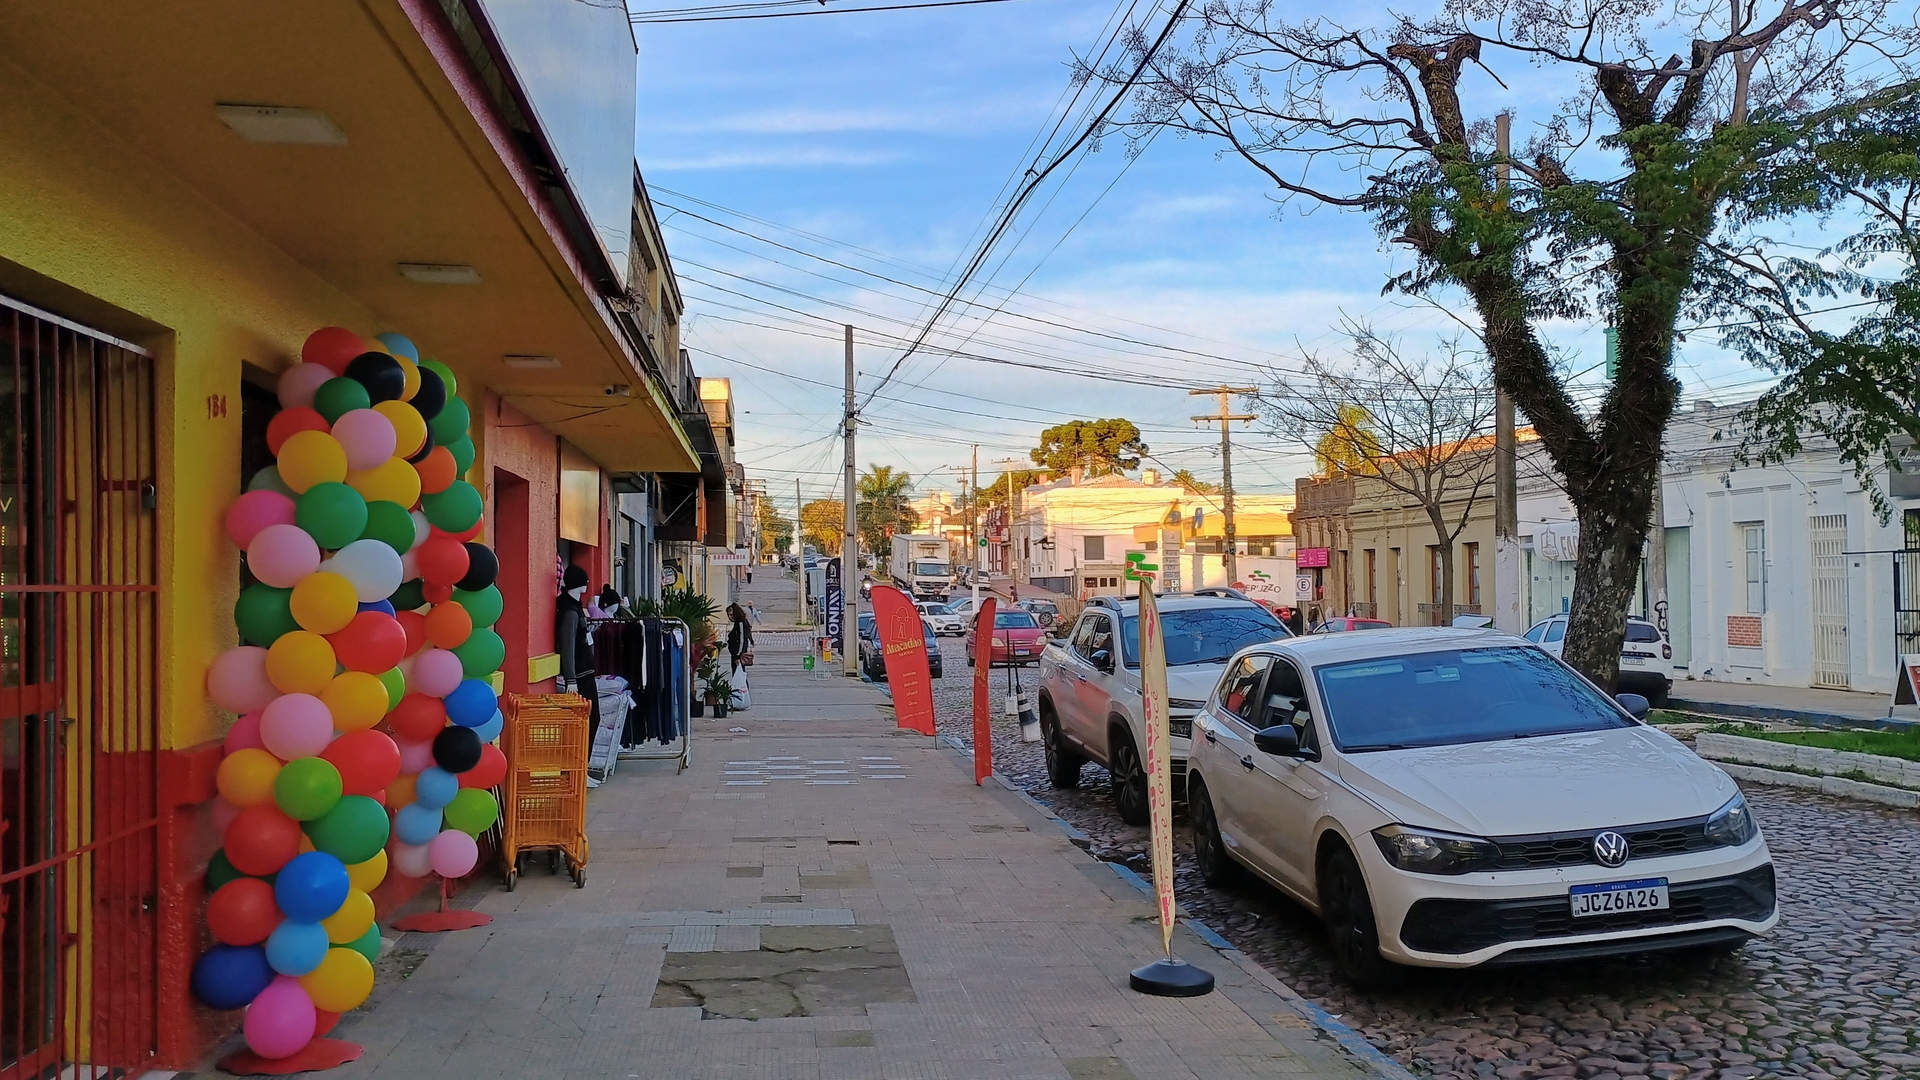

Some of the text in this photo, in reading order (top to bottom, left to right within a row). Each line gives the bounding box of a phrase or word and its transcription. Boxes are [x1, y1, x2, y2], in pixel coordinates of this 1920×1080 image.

[1245, 584, 1281, 593] ERUZZO
[1301, 581, 1306, 589] E
[1579, 889, 1659, 913] JCZ6A26
